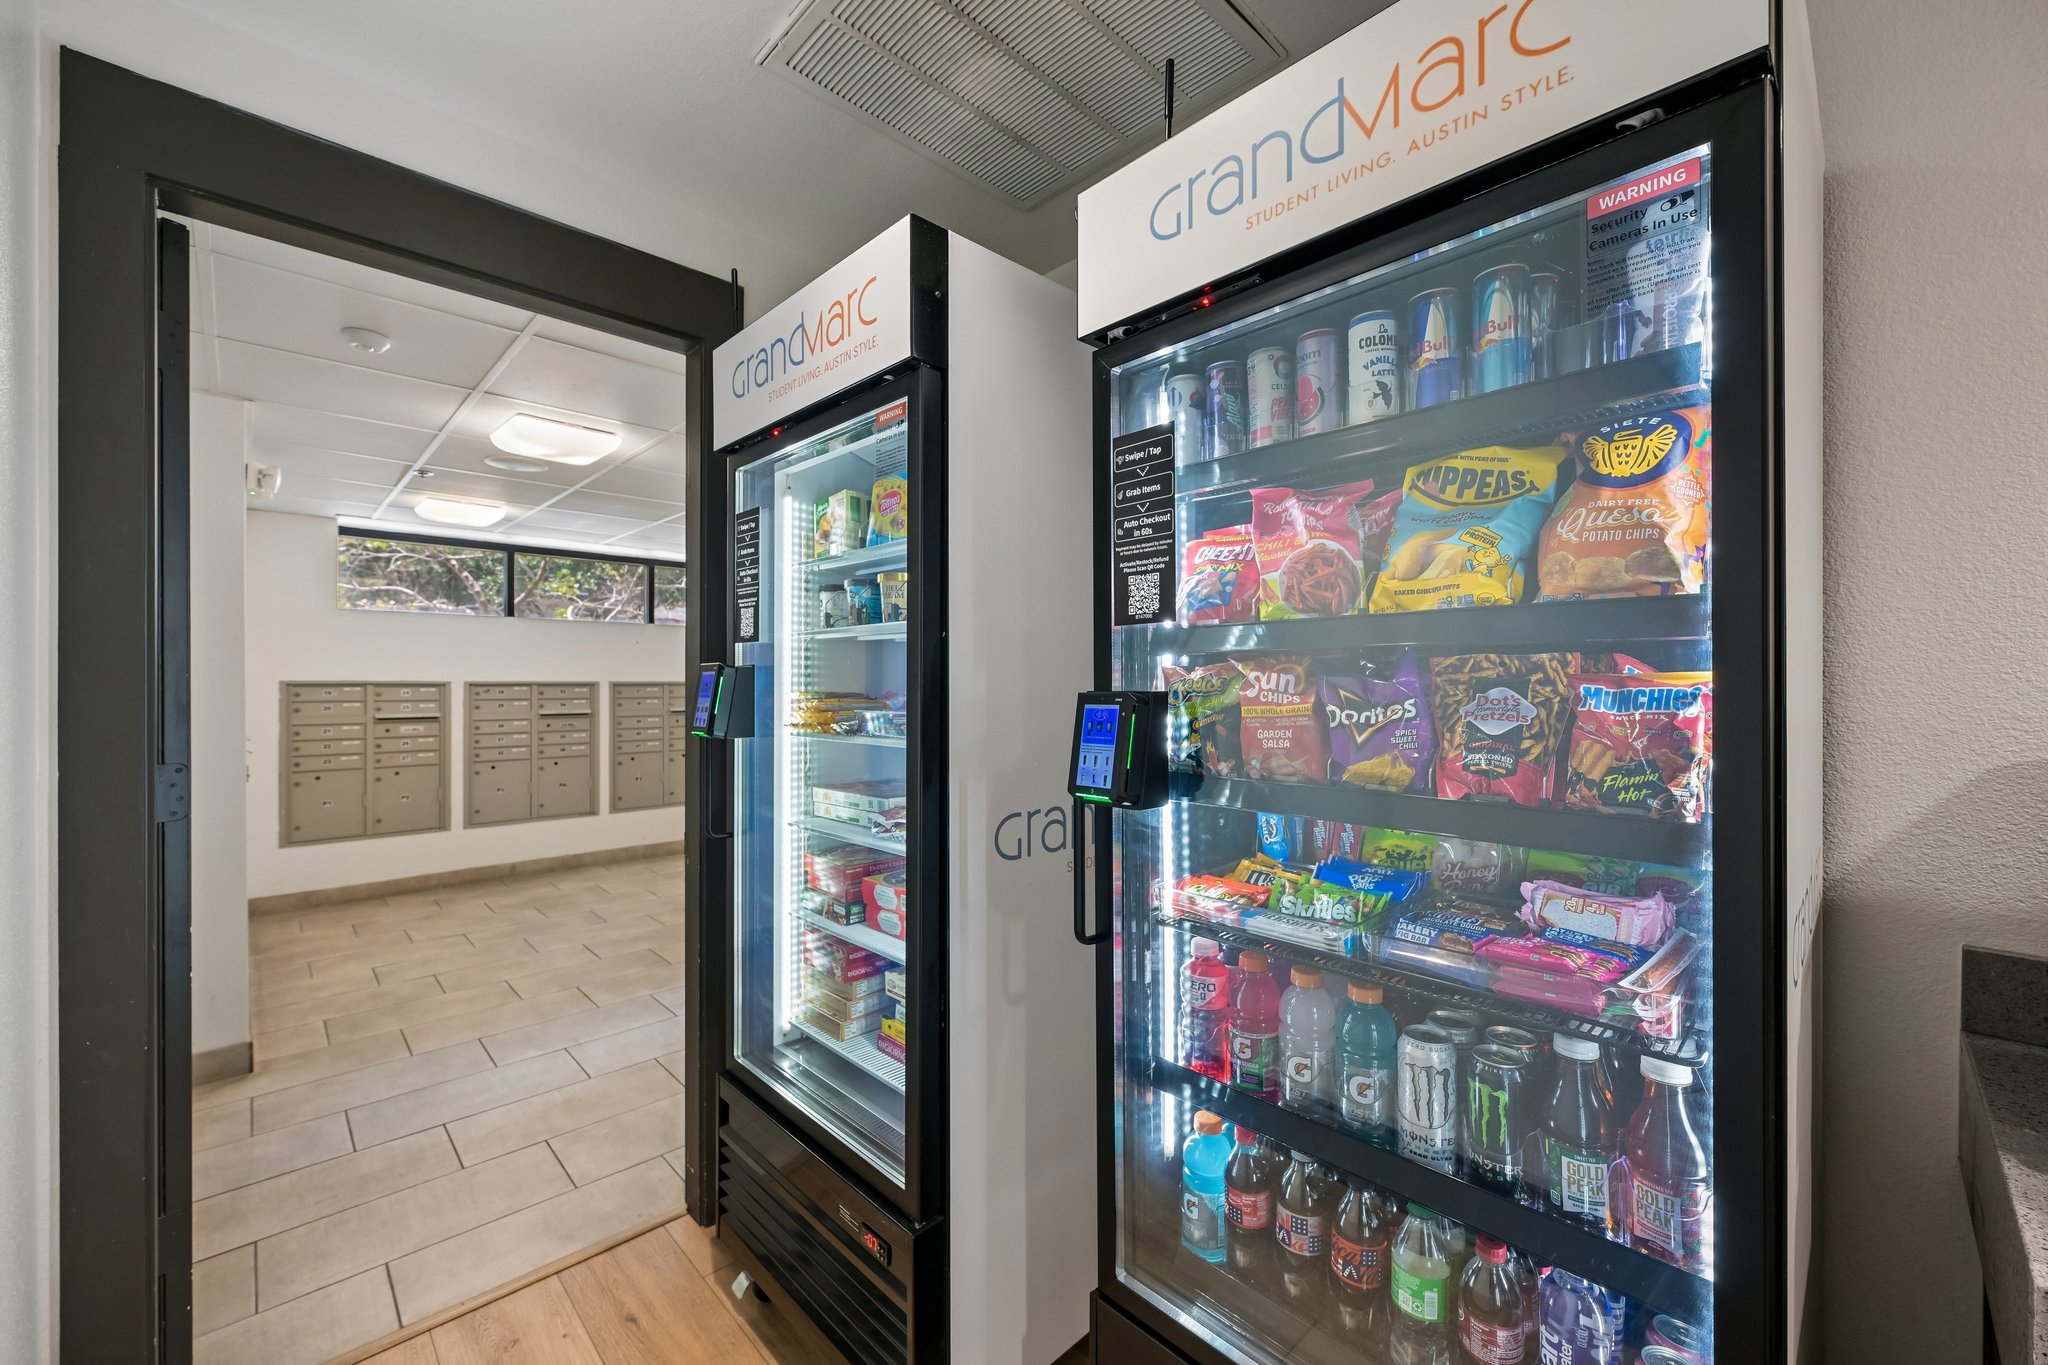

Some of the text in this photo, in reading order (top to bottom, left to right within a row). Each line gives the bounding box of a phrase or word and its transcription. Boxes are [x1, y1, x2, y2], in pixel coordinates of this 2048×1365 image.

[1245, 65, 1575, 230] STUDENT LIVING. AUSTIN STYLE.
[1599, 168, 1686, 210] WARNING
[1591, 207, 1648, 234] Security
[1589, 208, 1698, 251] Cameras In Use
[1625, 253, 1666, 270] prepayment.
[1667, 247, 1687, 256] When
[1688, 241, 1701, 250] you
[1620, 277, 1653, 290] deducting
[1665, 265, 1686, 276] actual
[1687, 261, 1702, 269] cost
[1676, 272, 1693, 281] time
[1637, 289, 1655, 298] bank
[1378, 323, 1388, 334] La
[1485, 315, 1519, 334] Bull
[1423, 336, 1450, 354] Bull
[768, 335, 879, 402] STUDENT LIVING. AUSTIN STYLE.
[1371, 369, 1396, 377] LATTE
[879, 406, 903, 422] WARNING
[1600, 417, 1662, 434] SIETE
[1125, 449, 1145, 462] Swipe
[1149, 445, 1162, 457] Tap
[1126, 483, 1161, 498] Grab Items
[1678, 479, 1701, 491] KETTLE
[1676, 486, 1701, 499] COOKED
[1588, 498, 1659, 509] DAIRY FREE
[1123, 512, 1171, 529] Auto Checkout
[1133, 527, 1153, 537] in 60s
[1464, 530, 1497, 548] PROTEIN
[1582, 528, 1660, 542] POTATO CHIPS
[1219, 562, 1245, 571] MIX
[1441, 583, 1461, 591] PUFFS
[1260, 692, 1301, 704] CHIPS
[1475, 693, 1521, 709] Dot's
[1243, 707, 1284, 716] 100% WHOLE
[1326, 698, 1417, 728] Doritos
[1463, 711, 1530, 725] Pretzels
[1257, 728, 1293, 739] GARDEN
[1395, 728, 1417, 737] SPICY
[1262, 739, 1290, 749] SALSA
[1390, 736, 1417, 744] SWEET
[1399, 742, 1418, 750] CHILI
[1468, 740, 1516, 752] ORIGINAL
[1467, 753, 1513, 764] SEASONED
[1491, 759, 1512, 769] TWISTS
[1618, 790, 1652, 803] Hot
[1343, 823, 1354, 844] Nutter
[1341, 831, 1351, 854] Butter
[1440, 863, 1498, 881] Honey
[1279, 895, 1358, 923] Skittles
[1410, 933, 1428, 944] BAR
[1190, 980, 1217, 993] ERO
[1409, 1149, 1453, 1162] ZERO ULTRA
[1567, 1161, 1605, 1183] GOLD
[1567, 1175, 1605, 1196] PEAK
[1636, 1184, 1675, 1214] GOLD
[1636, 1199, 1675, 1228] PEAK
